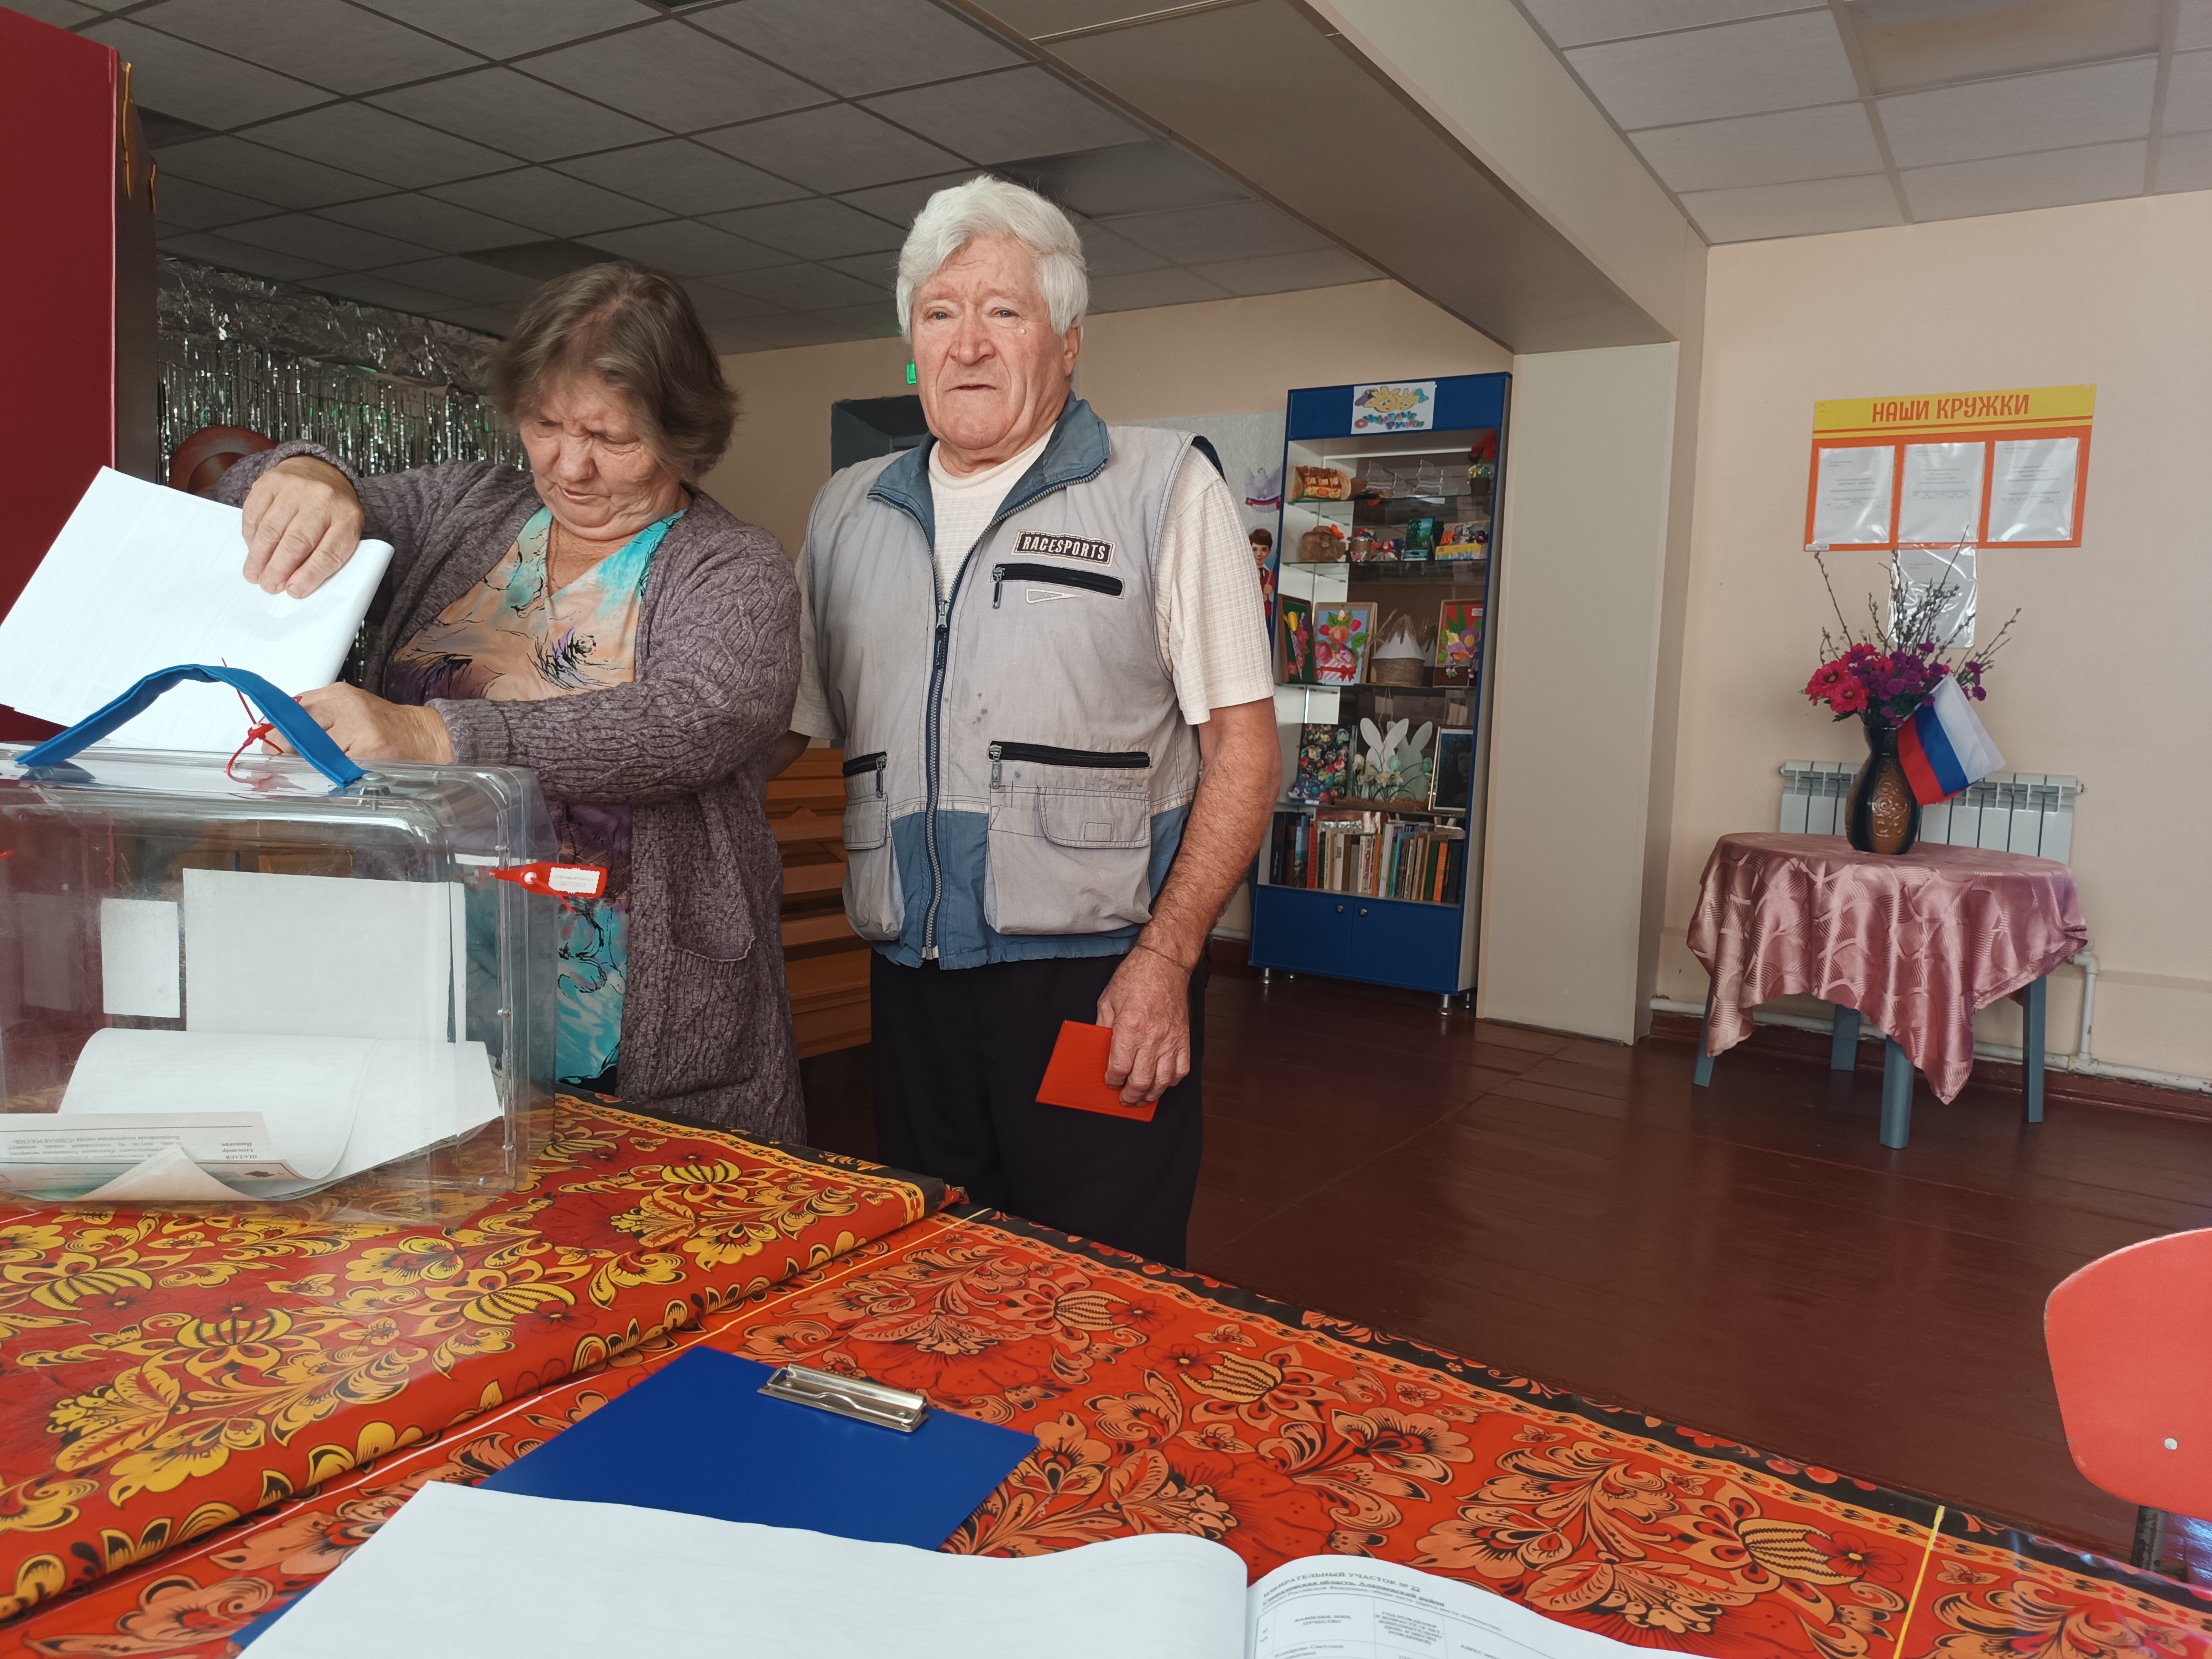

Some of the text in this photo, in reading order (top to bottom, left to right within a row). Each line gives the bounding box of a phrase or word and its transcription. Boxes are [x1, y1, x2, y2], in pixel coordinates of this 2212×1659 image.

[1872, 394, 2030, 422] НАШИ КРУЖКИ
[1022, 536, 1105, 560] RACESPORTS
[1348, 1573, 1397, 1585] УЧАСТОК
